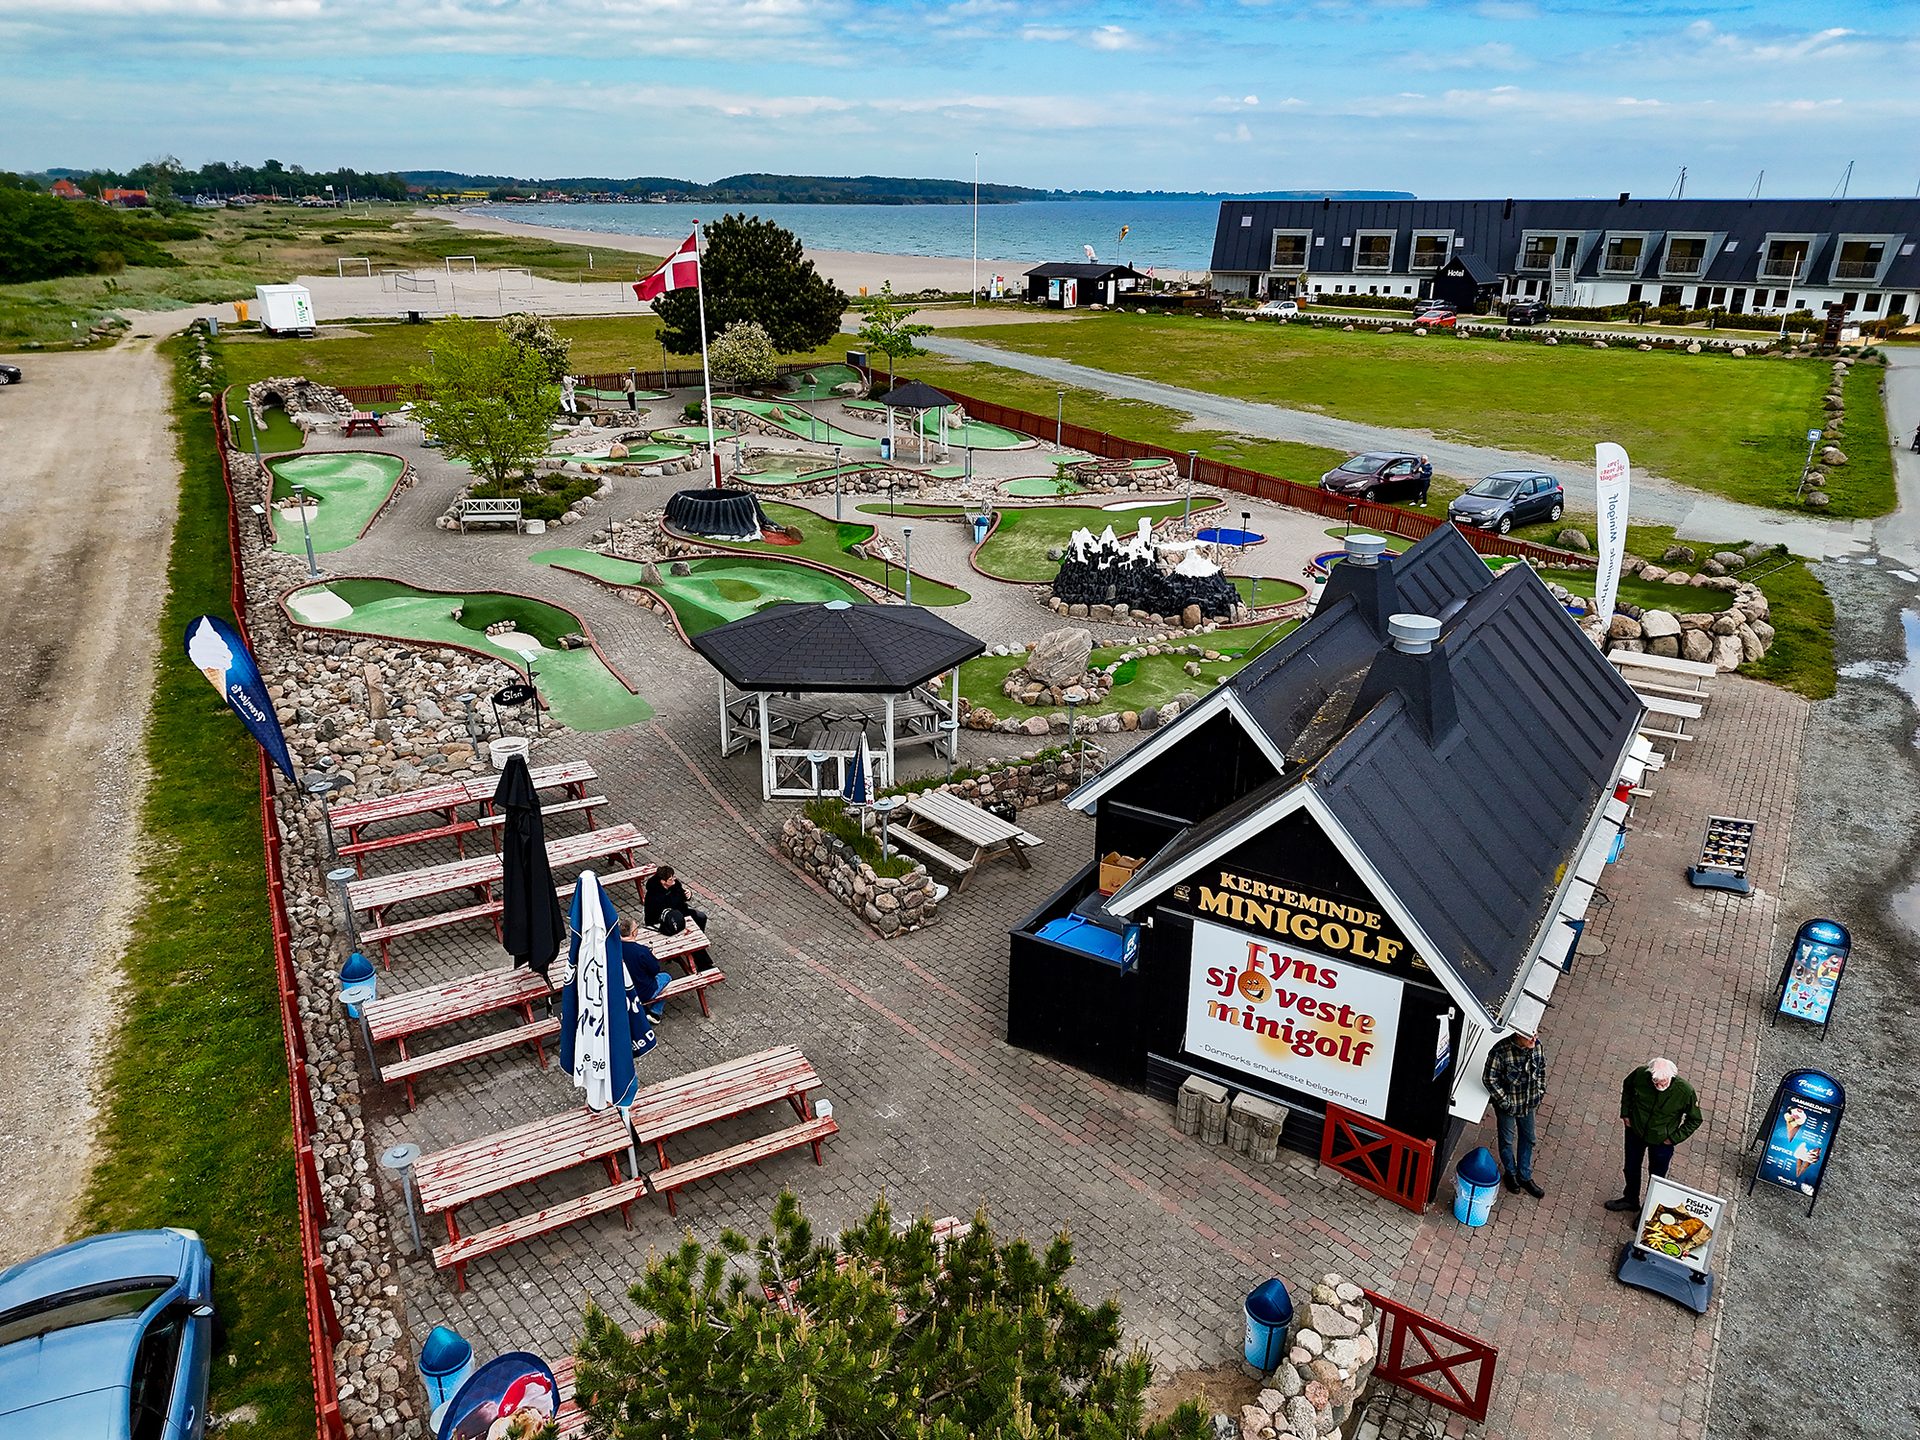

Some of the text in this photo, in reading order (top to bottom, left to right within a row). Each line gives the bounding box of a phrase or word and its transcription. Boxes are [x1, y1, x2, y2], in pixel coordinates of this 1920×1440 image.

[1447, 269, 1465, 277] Hotel
[1198, 886, 1404, 964] MINIGOLF
[1219, 871, 1382, 930] KERTEMINDE
[1245, 940, 1339, 990] Fyns
[1206, 999, 1375, 1067] minigolf
[1204, 1043, 1252, 1067] Danmarks
[1252, 1062, 1305, 1085] smukkeste
[1305, 1079, 1368, 1107] beliggenhed!
[1685, 1205, 1709, 1217] CHIPS
